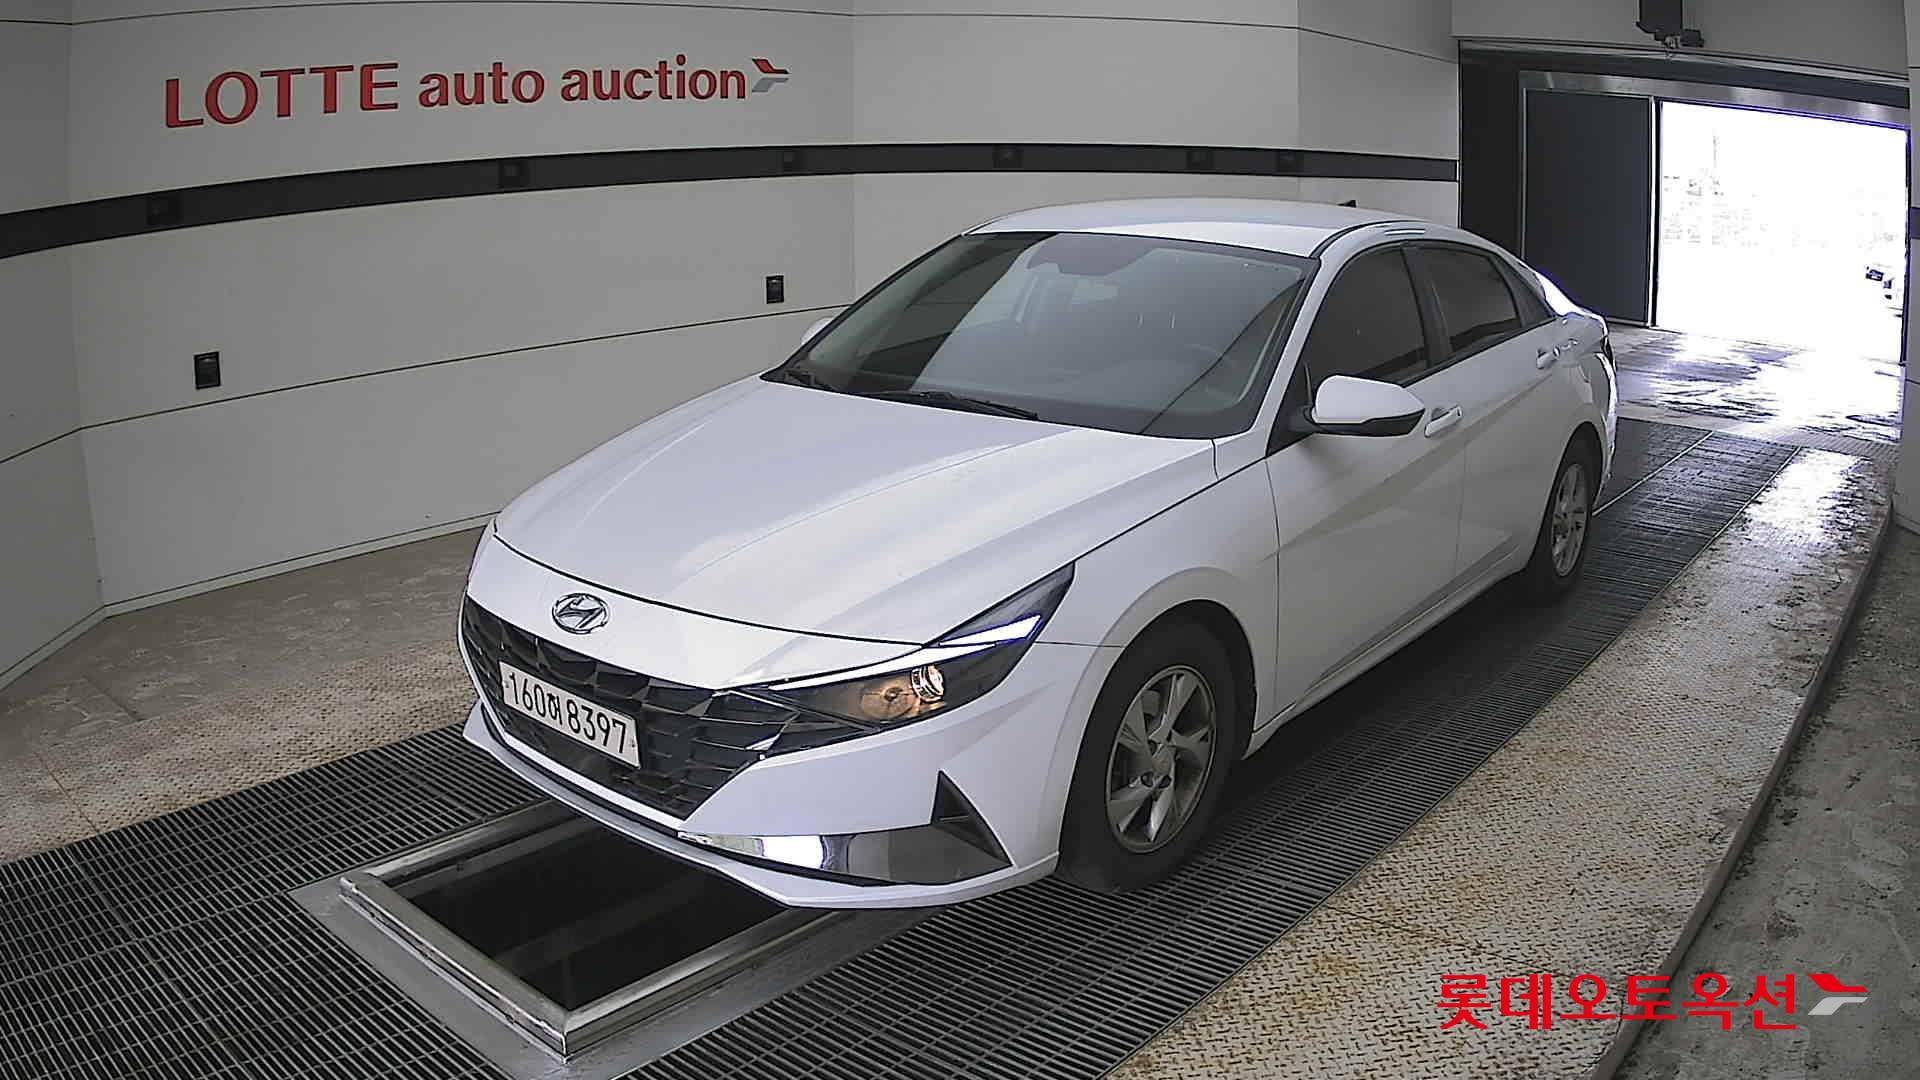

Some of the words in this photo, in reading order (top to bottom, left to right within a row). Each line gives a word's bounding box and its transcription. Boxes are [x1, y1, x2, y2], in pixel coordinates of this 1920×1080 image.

[165, 62, 399, 128] LOTTE
[418, 61, 546, 108] auto
[561, 54, 747, 103] auction
